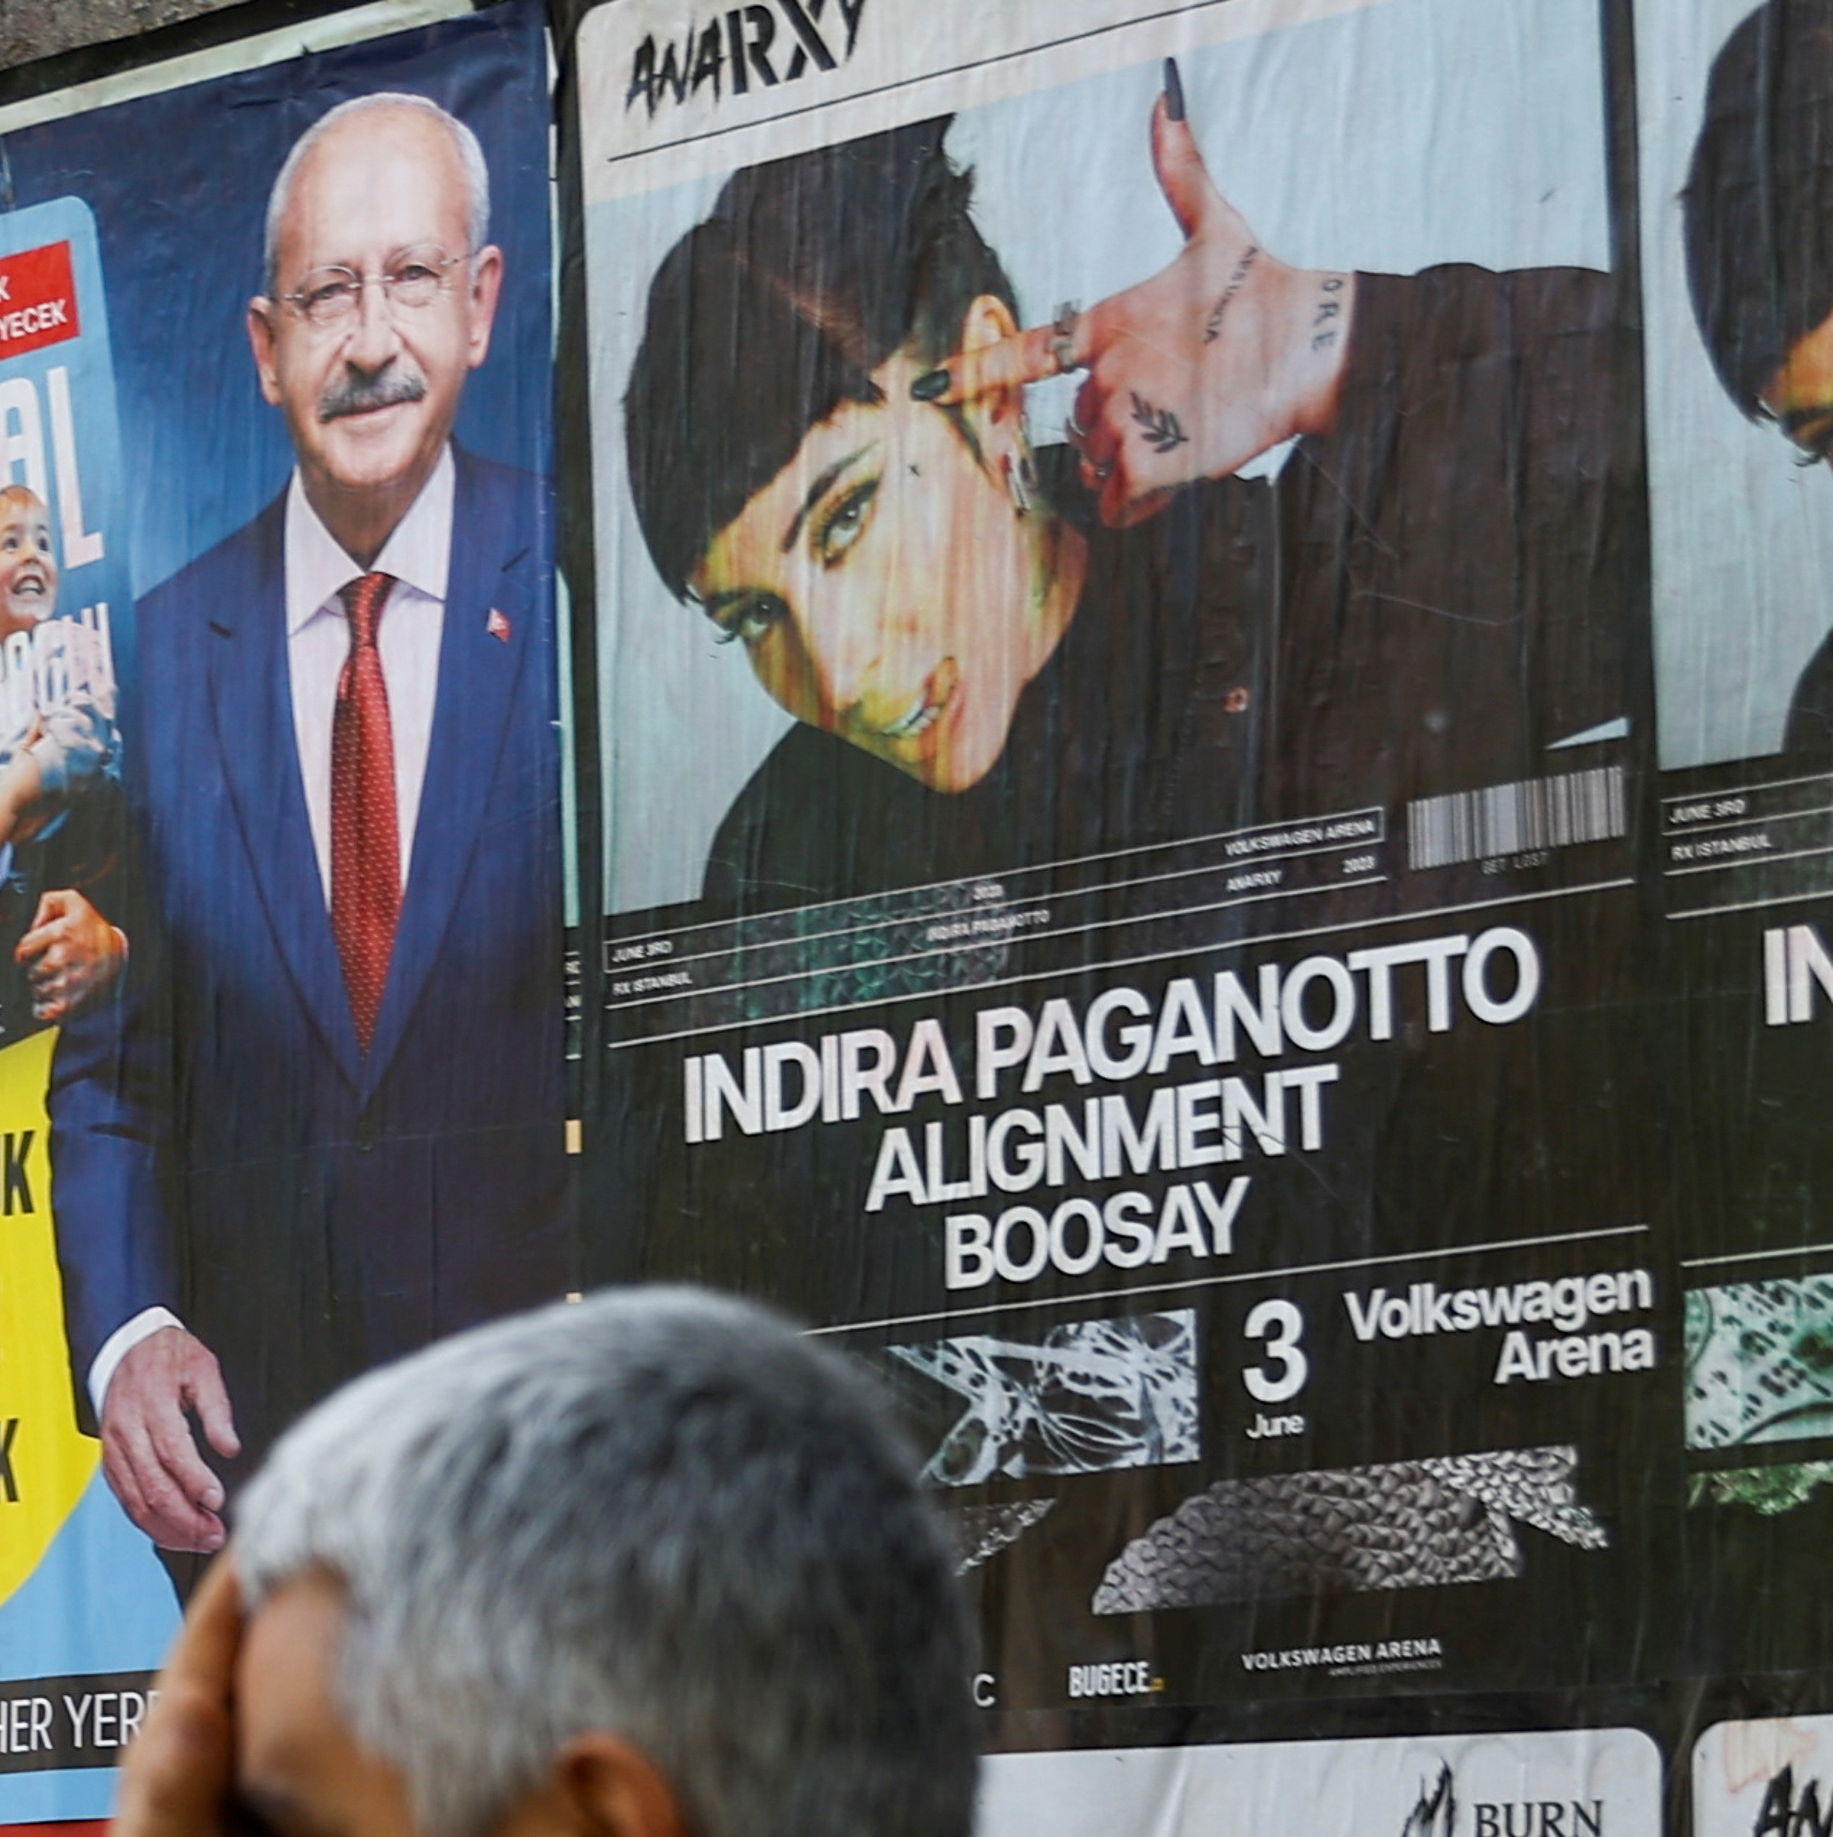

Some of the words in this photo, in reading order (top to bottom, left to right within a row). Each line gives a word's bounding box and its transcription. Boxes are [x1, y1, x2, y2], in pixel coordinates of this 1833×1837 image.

[1669, 804, 1711, 824] JUNE
[1714, 798, 1747, 818] 3RD
[1224, 828, 1323, 857] VOLKSWAGEN
[1325, 818, 1375, 840] ARENA
[1670, 845, 1693, 861] RX
[1695, 833, 1773, 858] ISTANBUL
[612, 945, 645, 963] JUNE
[684, 1018, 961, 1145] INDIRA
[974, 925, 1540, 1102] PAGANOTTO
[865, 1063, 1338, 1213] ALIGNMENT
[945, 1176, 1251, 1293] BOOSAY
[1342, 1266, 1653, 1343] Volkswagen
[1242, 1299, 1309, 1403] 3
[1494, 1323, 1655, 1387] Arena
[1246, 1410, 1305, 1440] June
[1241, 1644, 1371, 1672] VOLKSWAGEN
[1376, 1638, 1441, 1660] ARENA
